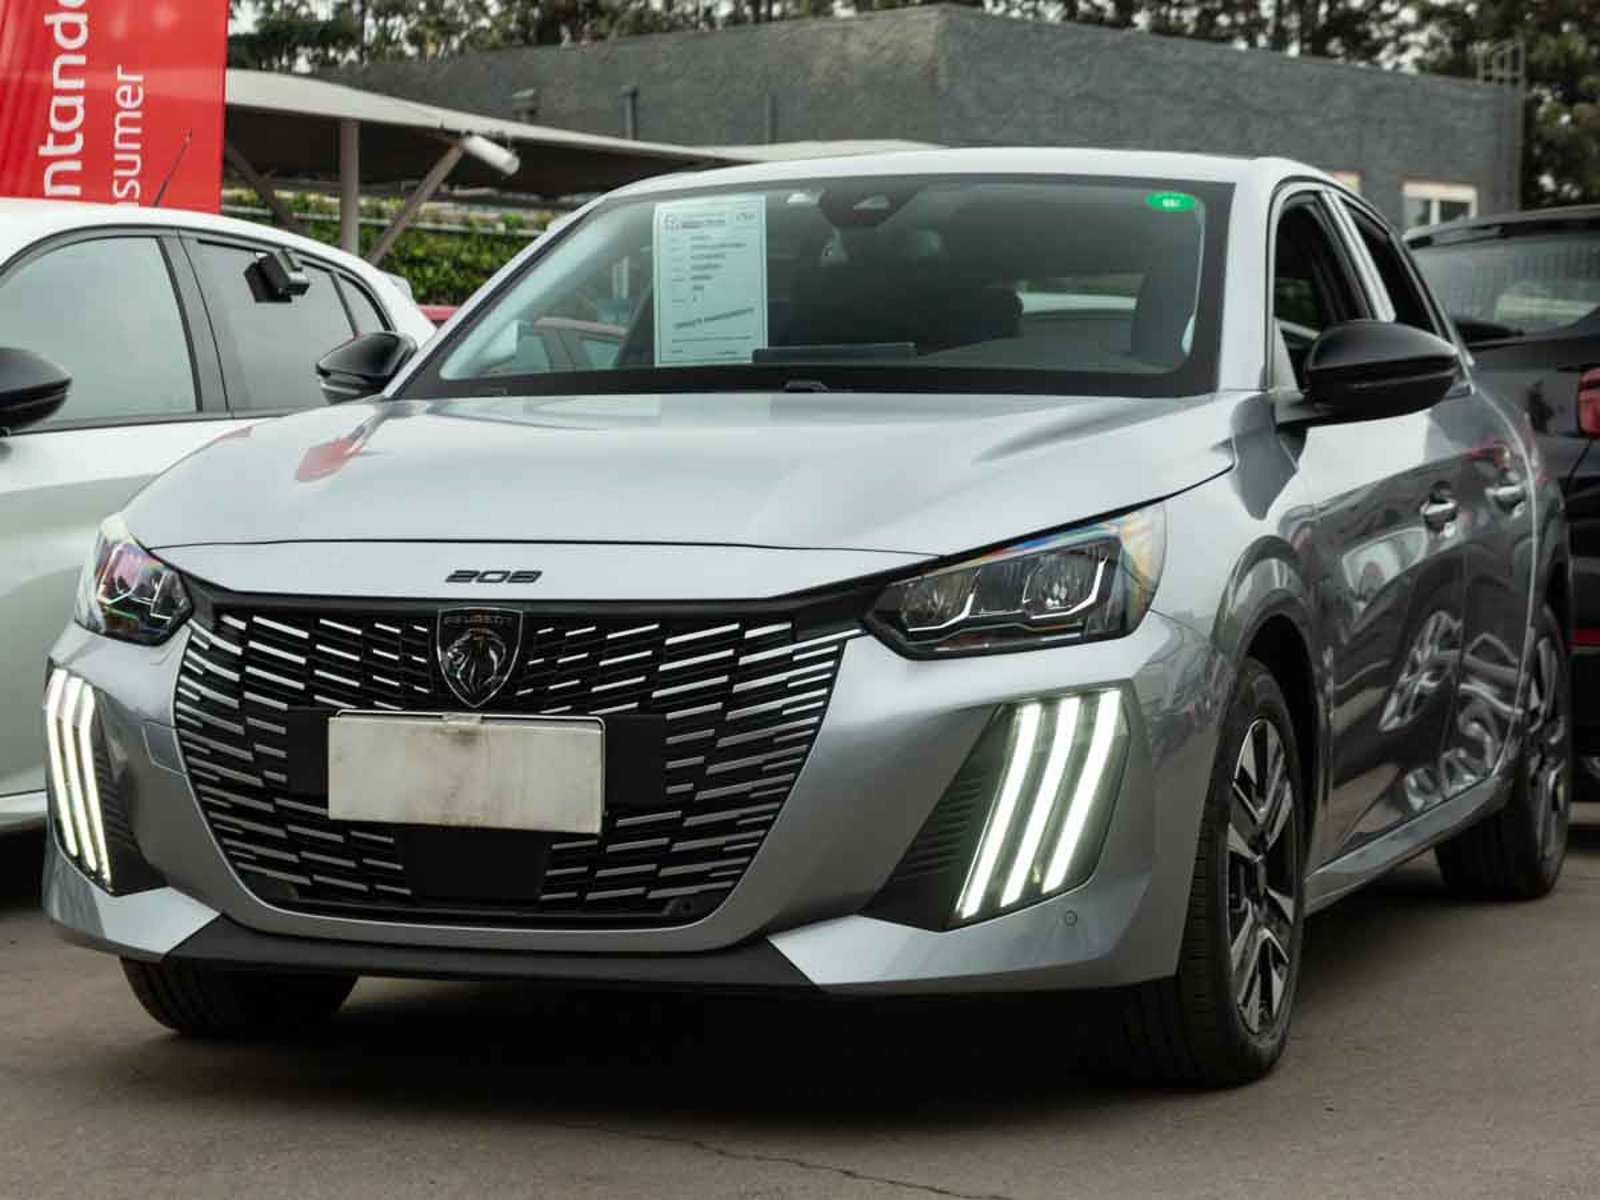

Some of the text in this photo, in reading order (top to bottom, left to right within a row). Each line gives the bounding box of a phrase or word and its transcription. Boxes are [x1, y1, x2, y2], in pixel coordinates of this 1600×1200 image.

[38, 0, 89, 197] ntand
[112, 64, 145, 207] sumer
[445, 570, 543, 584] 208
